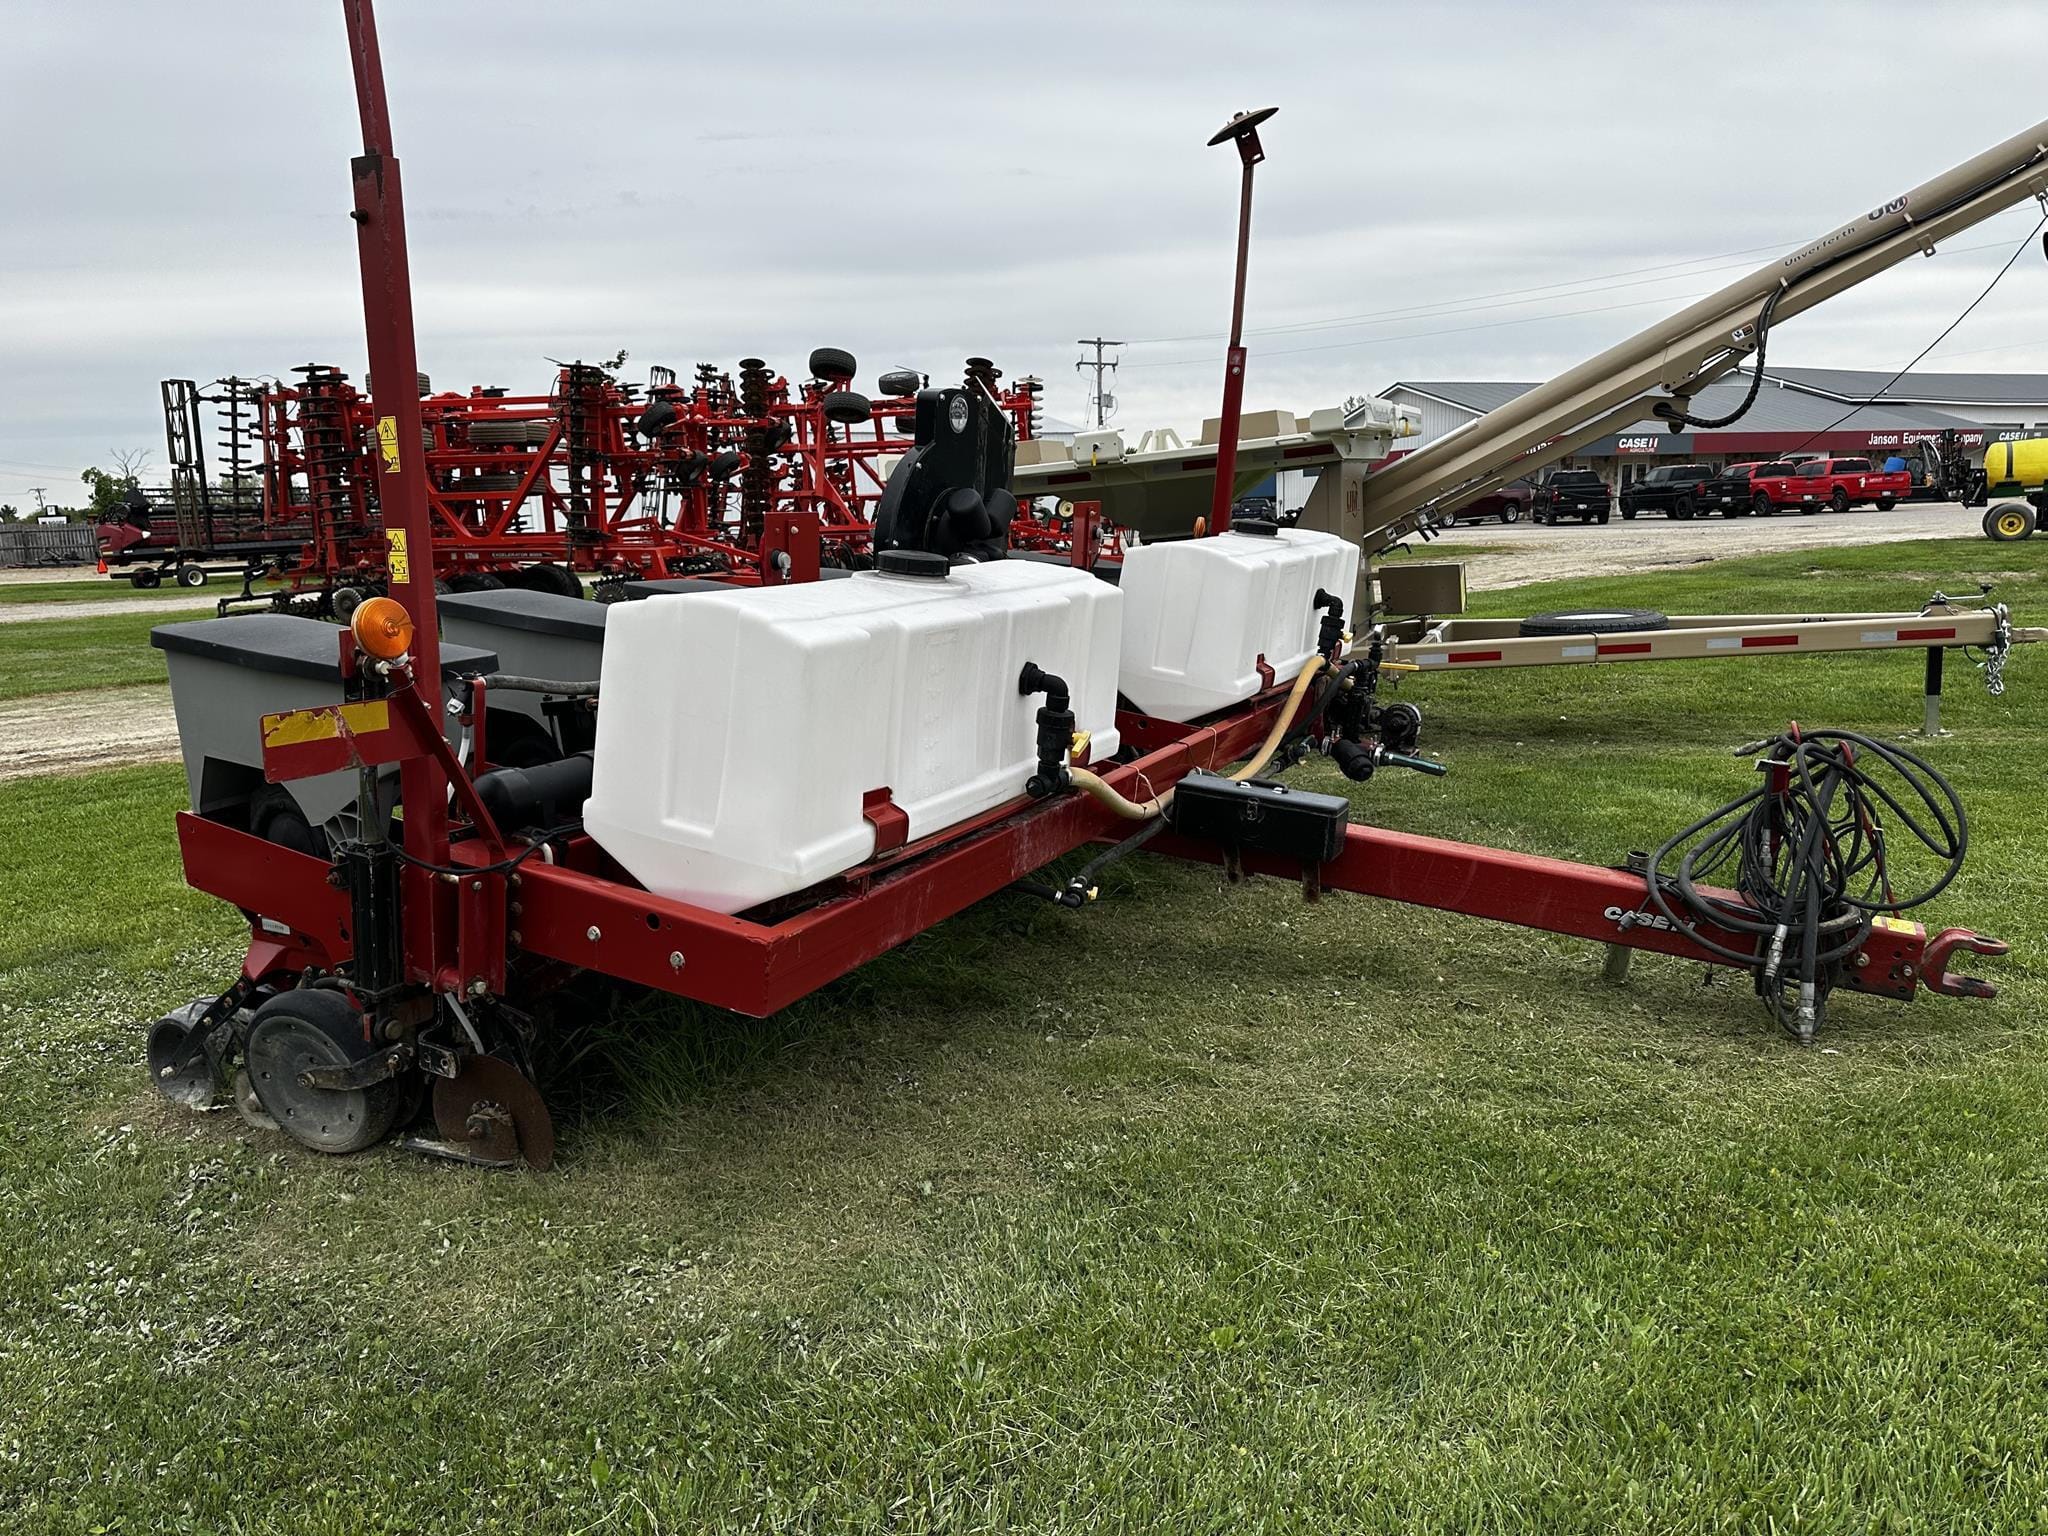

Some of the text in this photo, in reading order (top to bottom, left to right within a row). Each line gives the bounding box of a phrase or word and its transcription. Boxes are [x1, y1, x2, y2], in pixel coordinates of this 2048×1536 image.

[1868, 196, 1906, 221] UM
[1784, 226, 1855, 267] Unverforth
[1869, 433, 1898, 445] Janson
[1999, 431, 2021, 441] CASE
[1618, 437, 1649, 449] CASE
